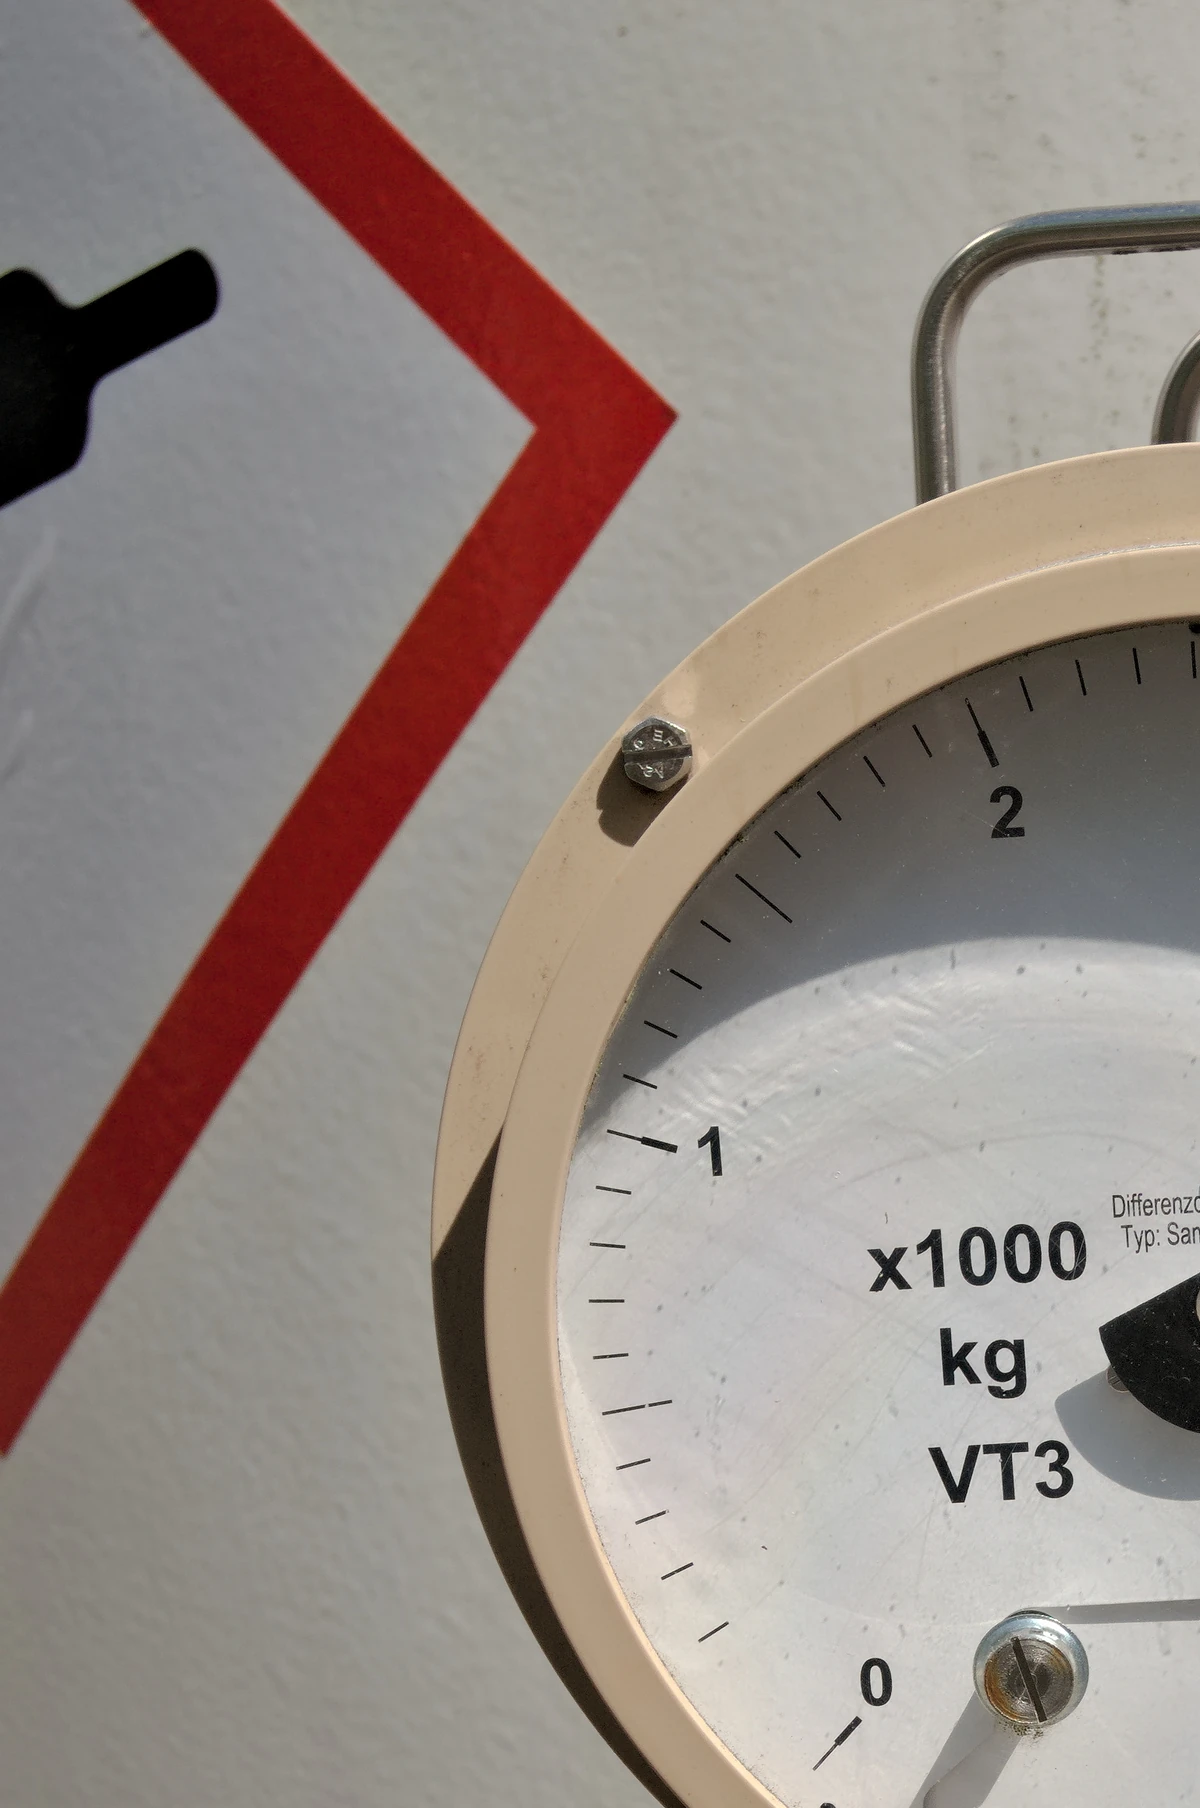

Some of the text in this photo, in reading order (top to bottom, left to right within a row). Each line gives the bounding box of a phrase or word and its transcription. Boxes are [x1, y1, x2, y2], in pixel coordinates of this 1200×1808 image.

[989, 785, 1026, 839] 2
[697, 1126, 723, 1177] 1
[867, 1221, 1087, 1293] x1000
[1120, 1224, 1161, 1254] Typ:
[939, 1327, 1027, 1400] kg
[927, 1439, 1074, 1504] VT3
[860, 1657, 893, 1707] 0
